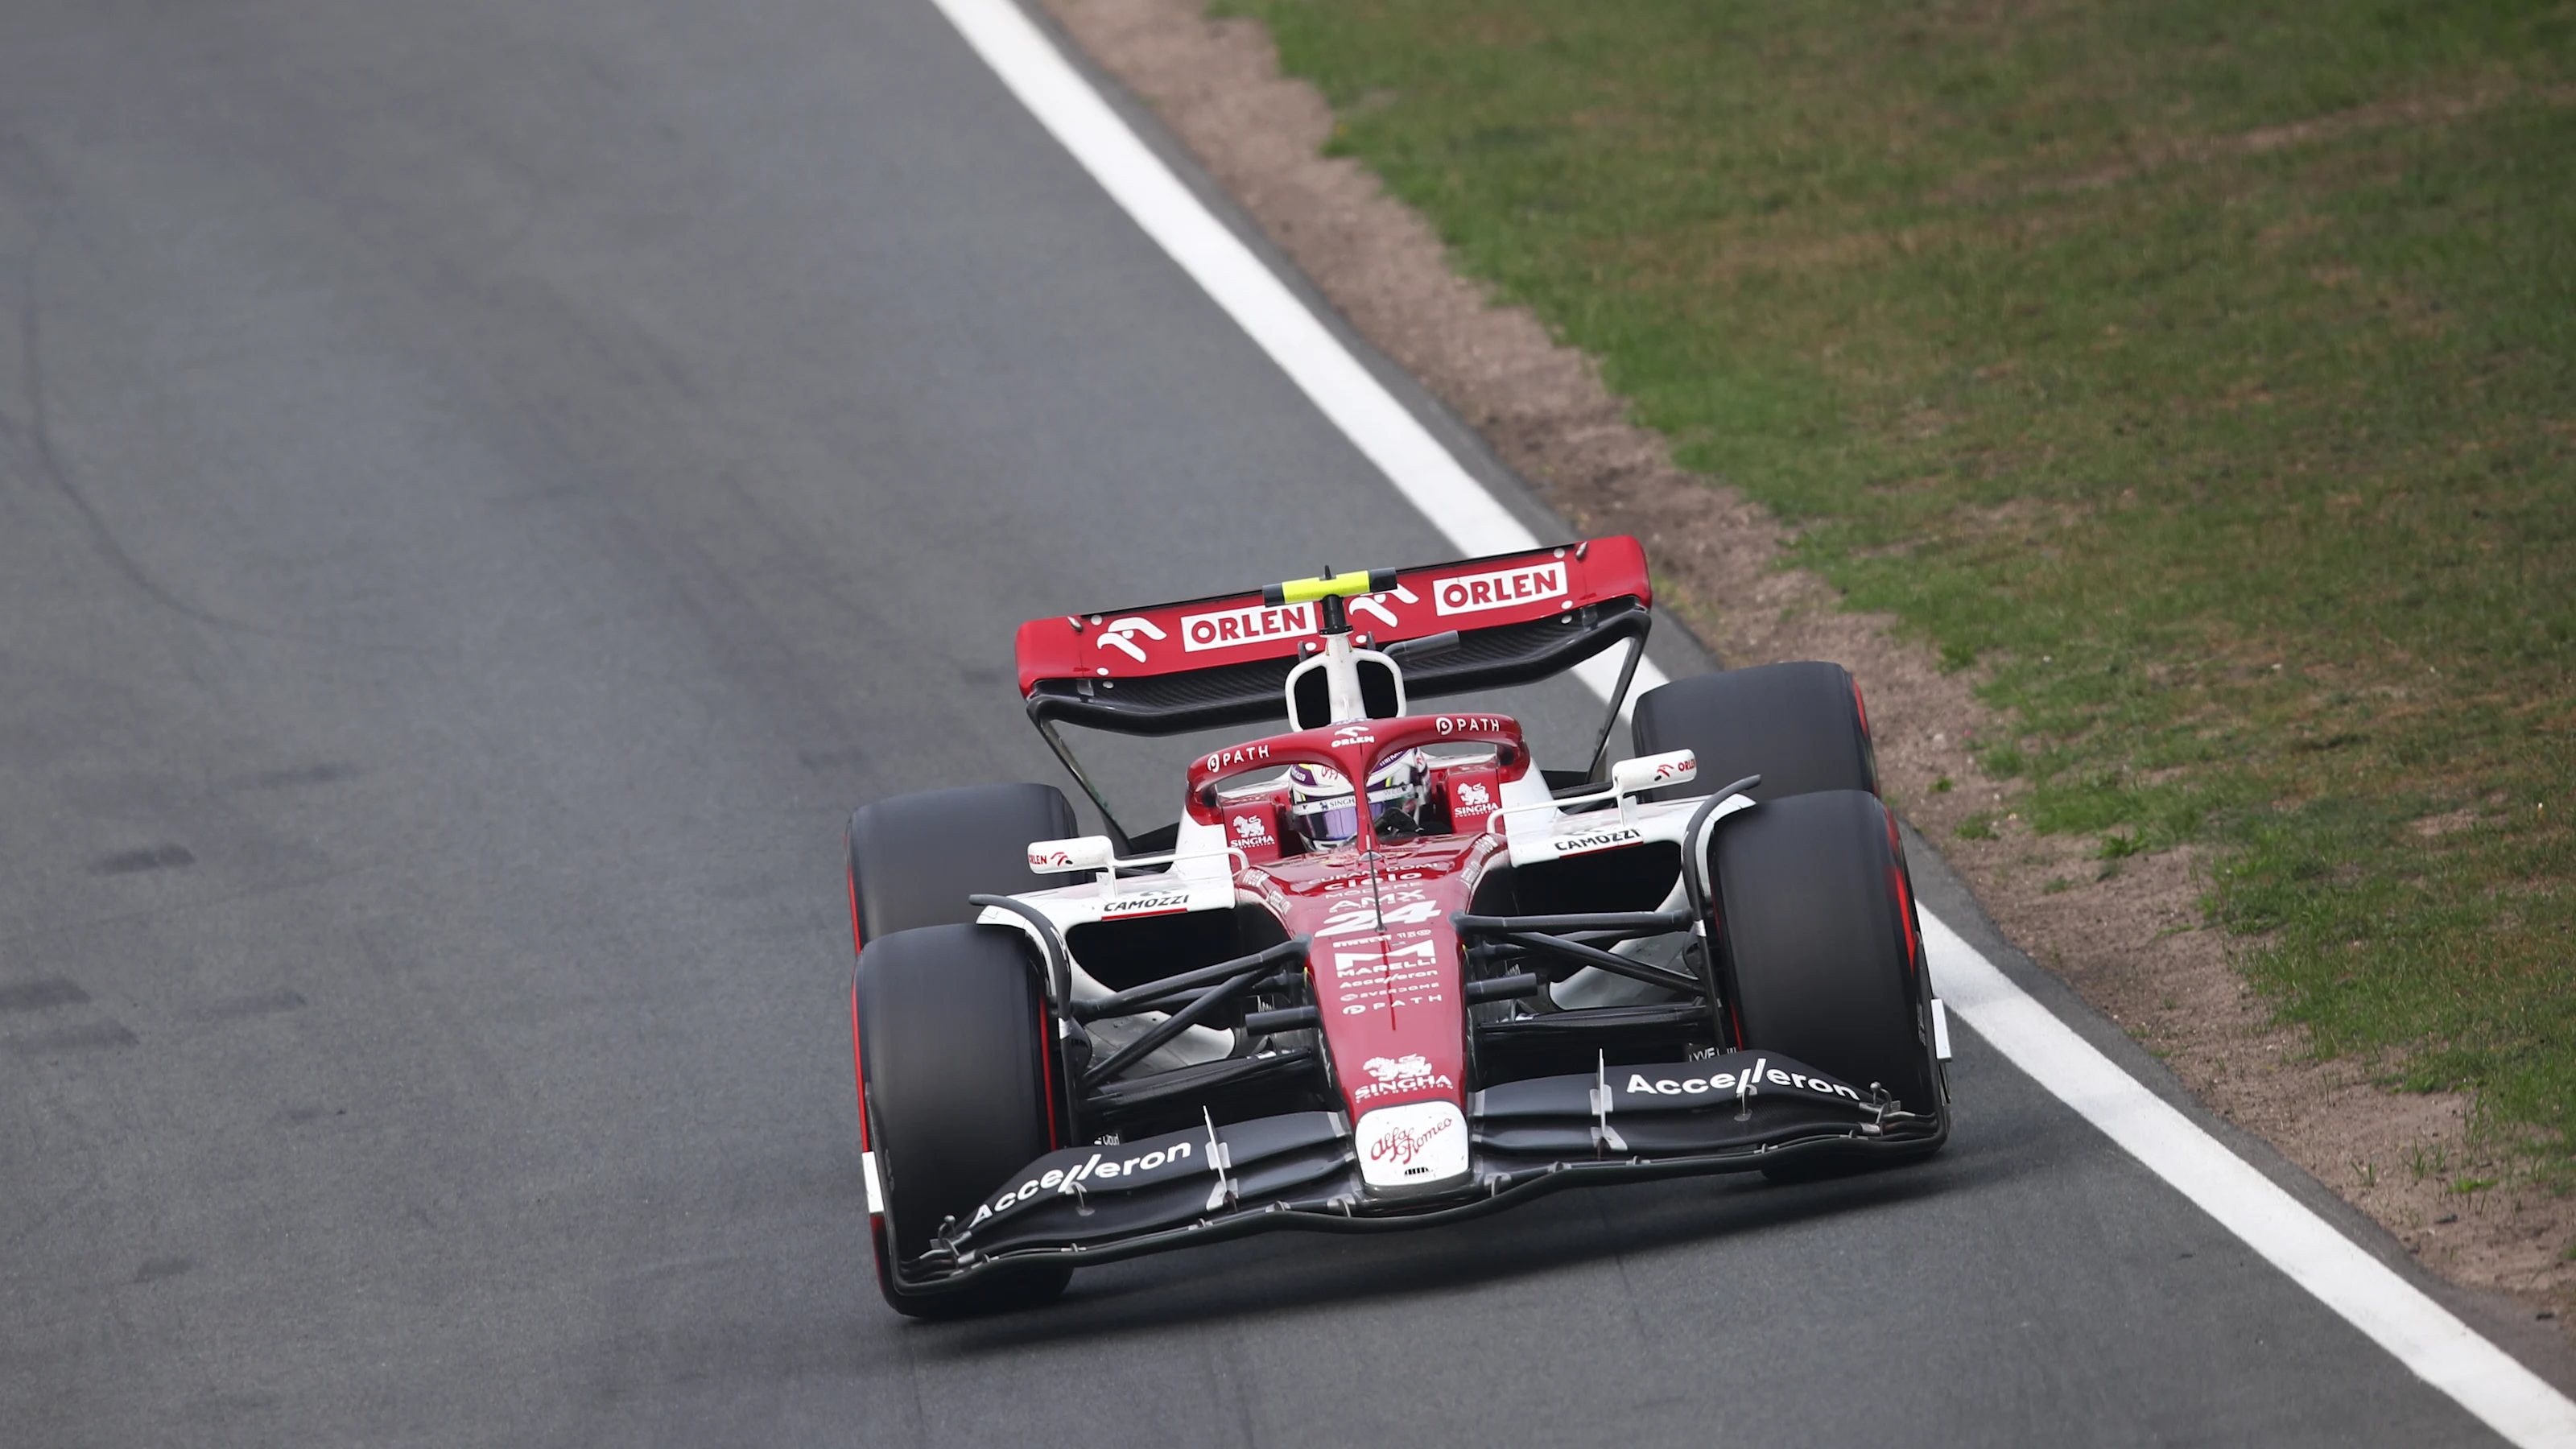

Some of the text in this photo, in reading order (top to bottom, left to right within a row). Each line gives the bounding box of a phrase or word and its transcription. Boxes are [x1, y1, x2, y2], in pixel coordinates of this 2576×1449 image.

[1443, 569, 1558, 608] ORLEN
[1191, 606, 1307, 644] ORLEN
[1456, 717, 1500, 732] PATH
[1331, 735, 1375, 748] ORLEN
[1222, 745, 1269, 766] PATH
[1454, 802, 1499, 815] SINGHA
[1230, 835, 1274, 848] SINGHA
[1554, 828, 1641, 852] CAMOZZI
[1103, 894, 1191, 913] CAMOZZI
[1314, 899, 1442, 938] 24
[1336, 957, 1437, 978] MARELLI
[1373, 994, 1443, 1010] PATH
[1355, 1075, 1452, 1100] SINGHA
[1626, 1057, 1861, 1100] Accelleron
[1370, 1117, 1453, 1165] Alfa Romeo
[968, 1141, 1191, 1230] Accelleron
